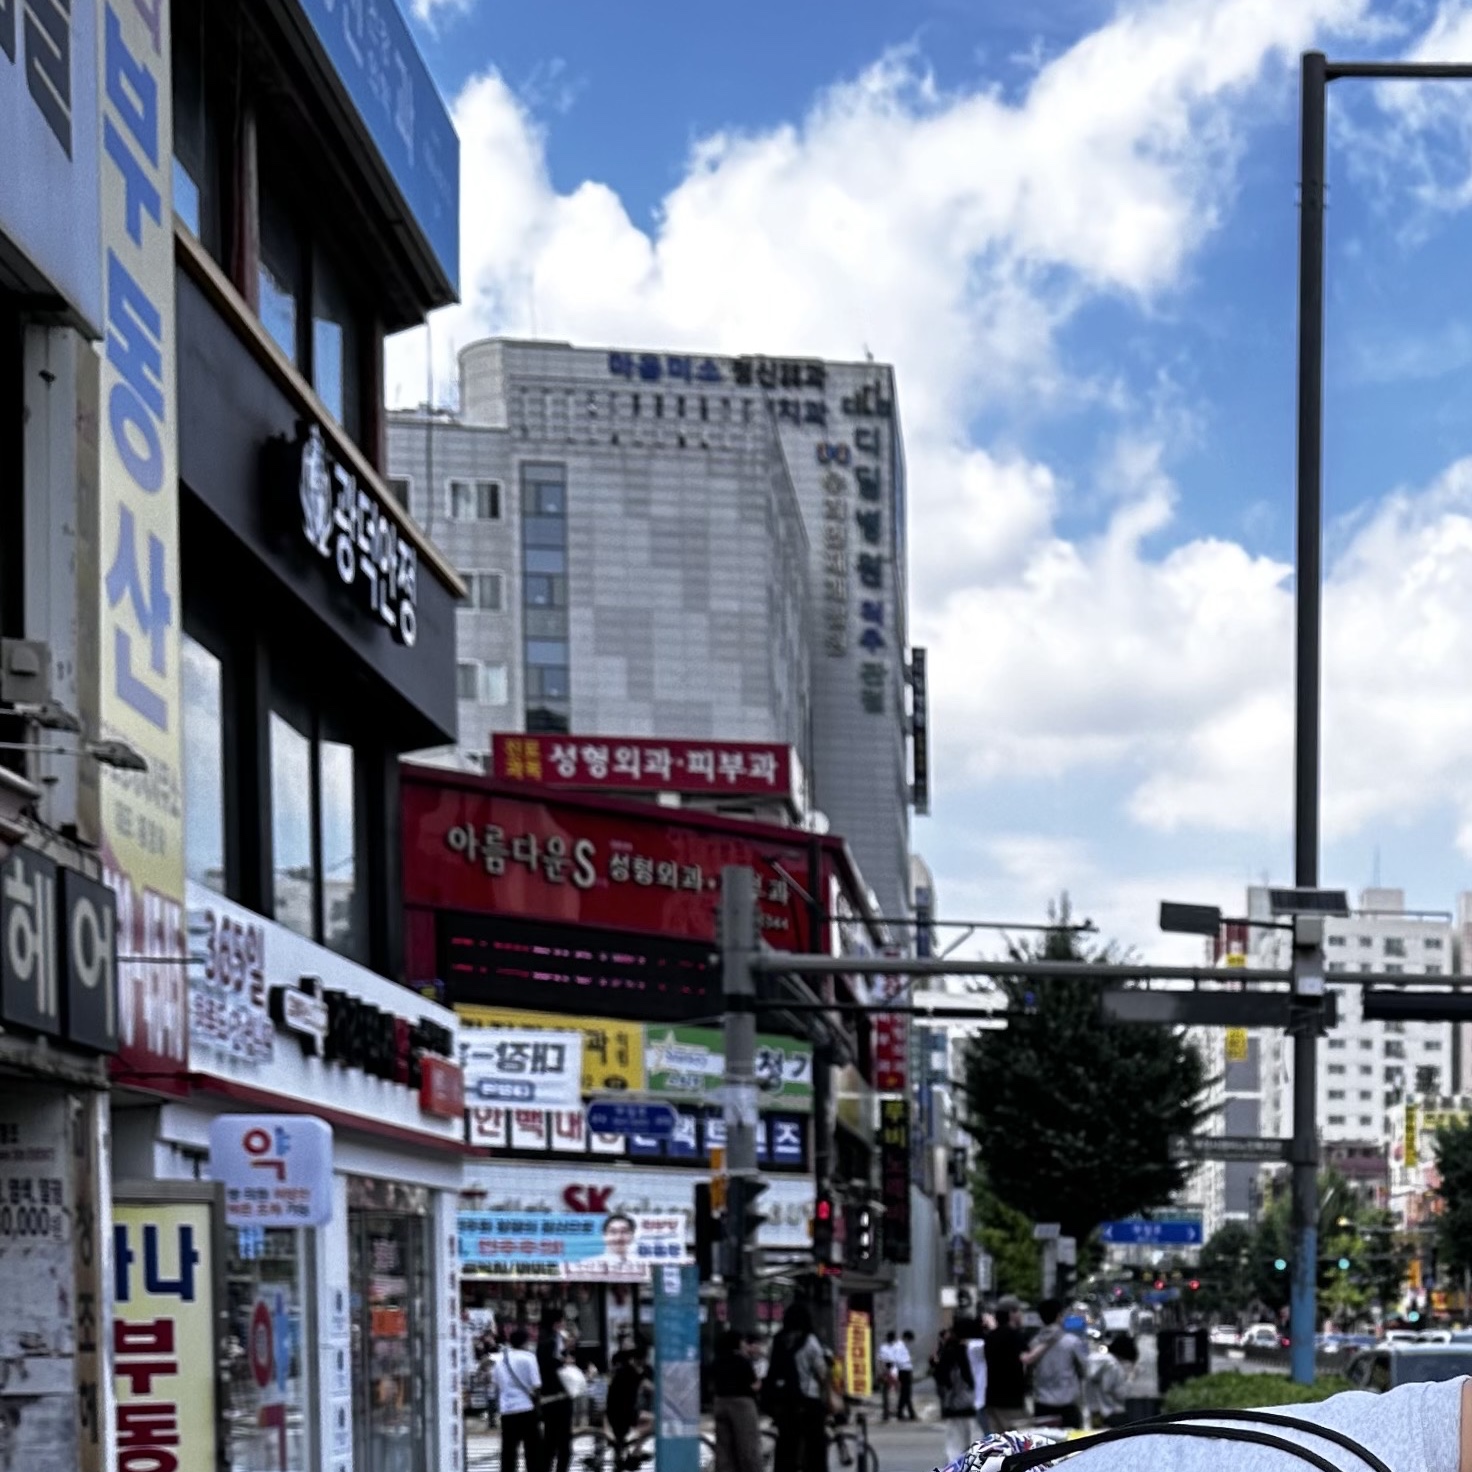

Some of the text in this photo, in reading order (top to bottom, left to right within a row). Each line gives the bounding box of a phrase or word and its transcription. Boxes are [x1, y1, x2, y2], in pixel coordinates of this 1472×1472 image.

[551, 743, 779, 786] 성형외과·피부과
[2, 855, 116, 1043] 헤어
[242, 1126, 291, 1182] 약
